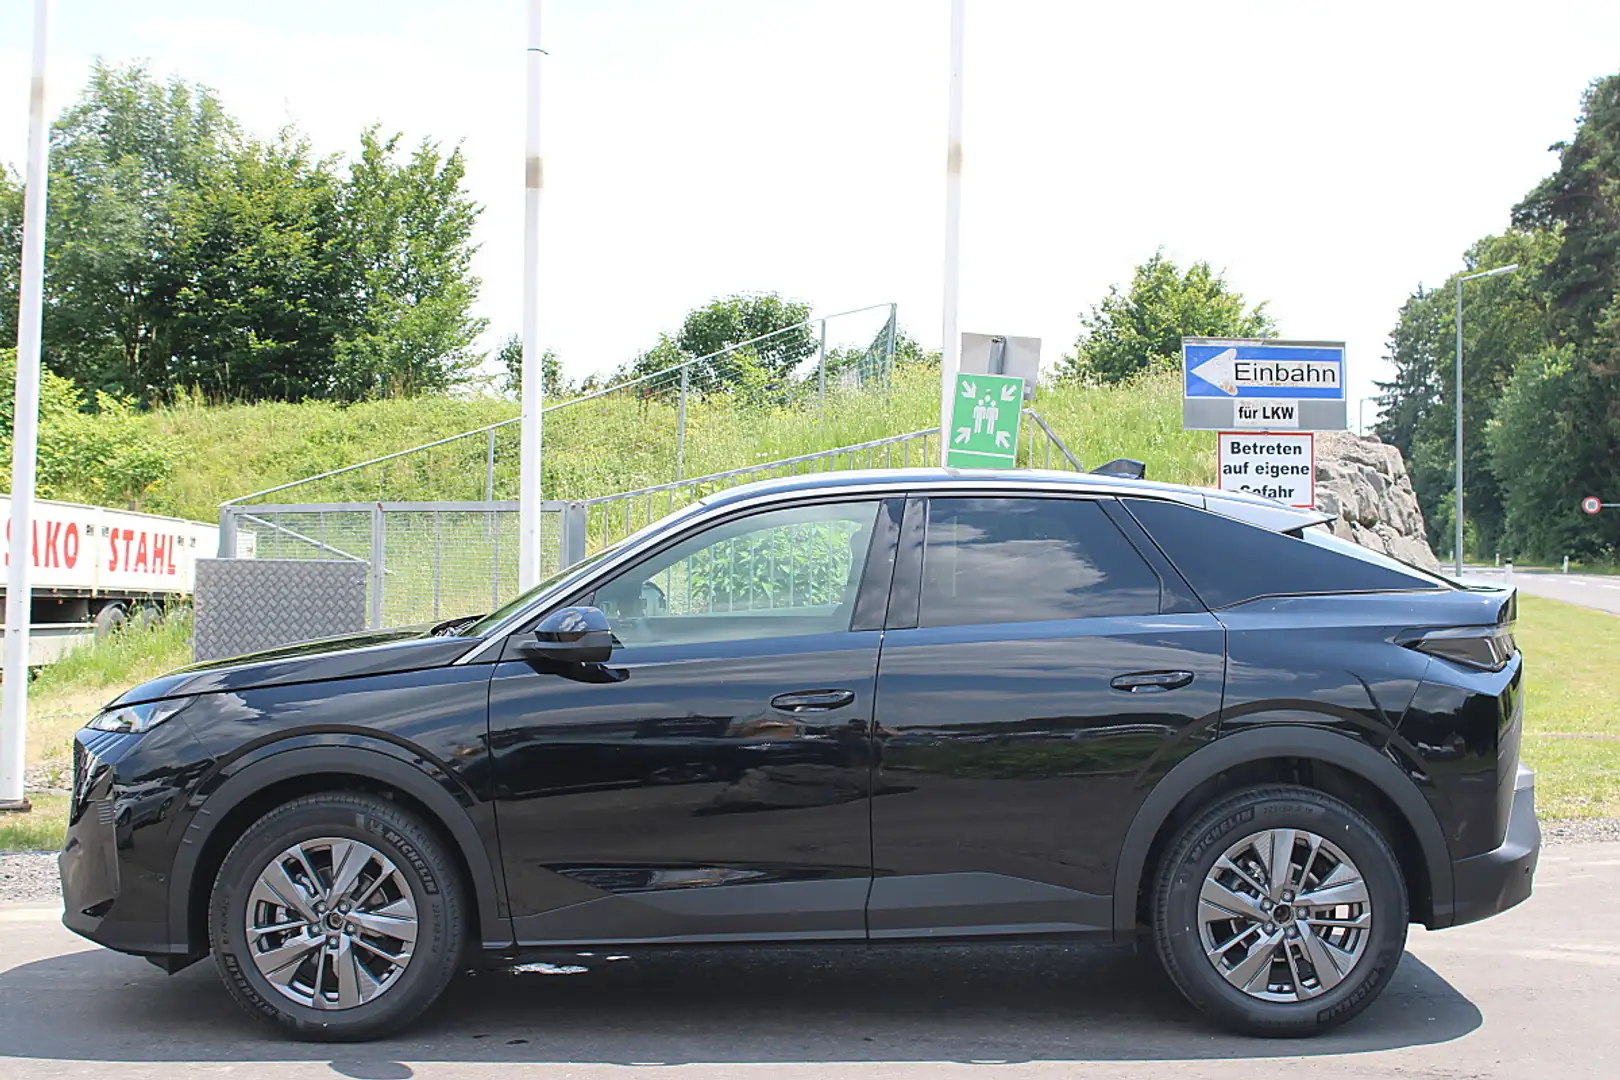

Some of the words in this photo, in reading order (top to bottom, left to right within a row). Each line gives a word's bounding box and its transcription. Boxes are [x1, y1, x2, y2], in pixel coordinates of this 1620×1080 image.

[1235, 362, 1336, 383] Einbahn
[1238, 406, 1258, 420] für
[1262, 406, 1295, 420] LKW
[1230, 441, 1302, 455] Betreten
[1223, 461, 1249, 475] auf
[1255, 461, 1310, 478] eigene
[109, 527, 177, 575] STAHL
[1191, 809, 1253, 861] MICHELIN
[384, 830, 438, 894] MICHELIN
